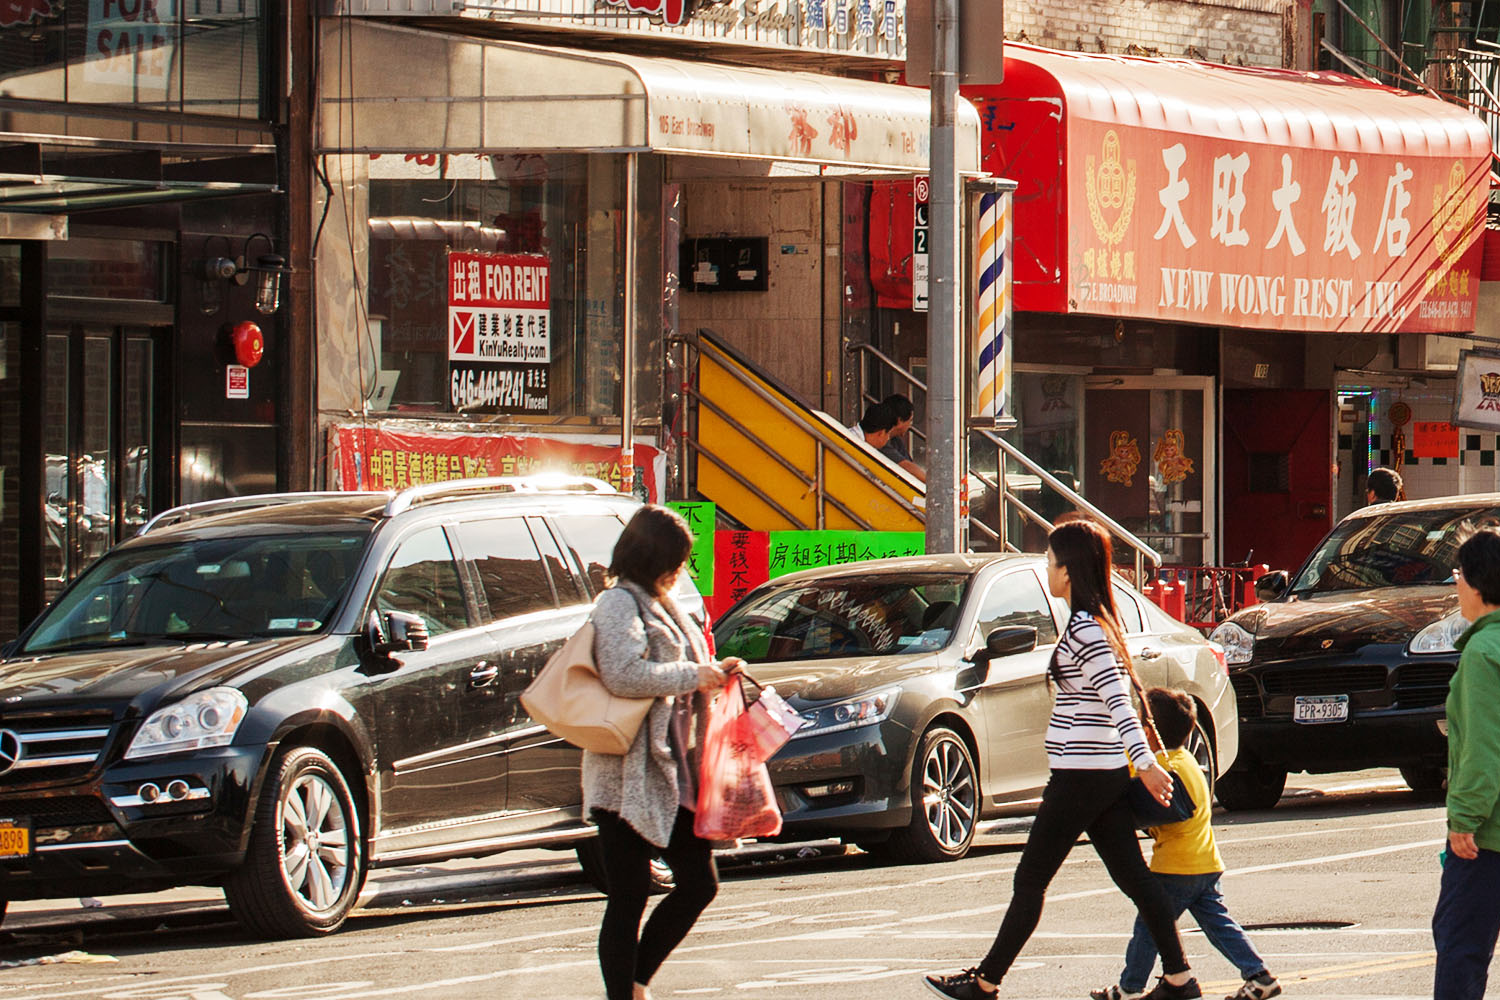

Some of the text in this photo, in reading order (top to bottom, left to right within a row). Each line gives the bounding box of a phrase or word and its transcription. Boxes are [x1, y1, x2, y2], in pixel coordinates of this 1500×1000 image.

[1154, 143, 1414, 260] 天旺大飯店
[917, 231, 925, 252] 2
[453, 260, 548, 301] 出租 FOR RENT
[1158, 267, 1212, 309] NEW
[1219, 272, 1286, 317] WONG
[1293, 276, 1356, 319] REST.
[1361, 281, 1407, 320] INC.
[479, 340, 546, 361] KinYuRealty.com
[0, 830, 23, 848] 898
